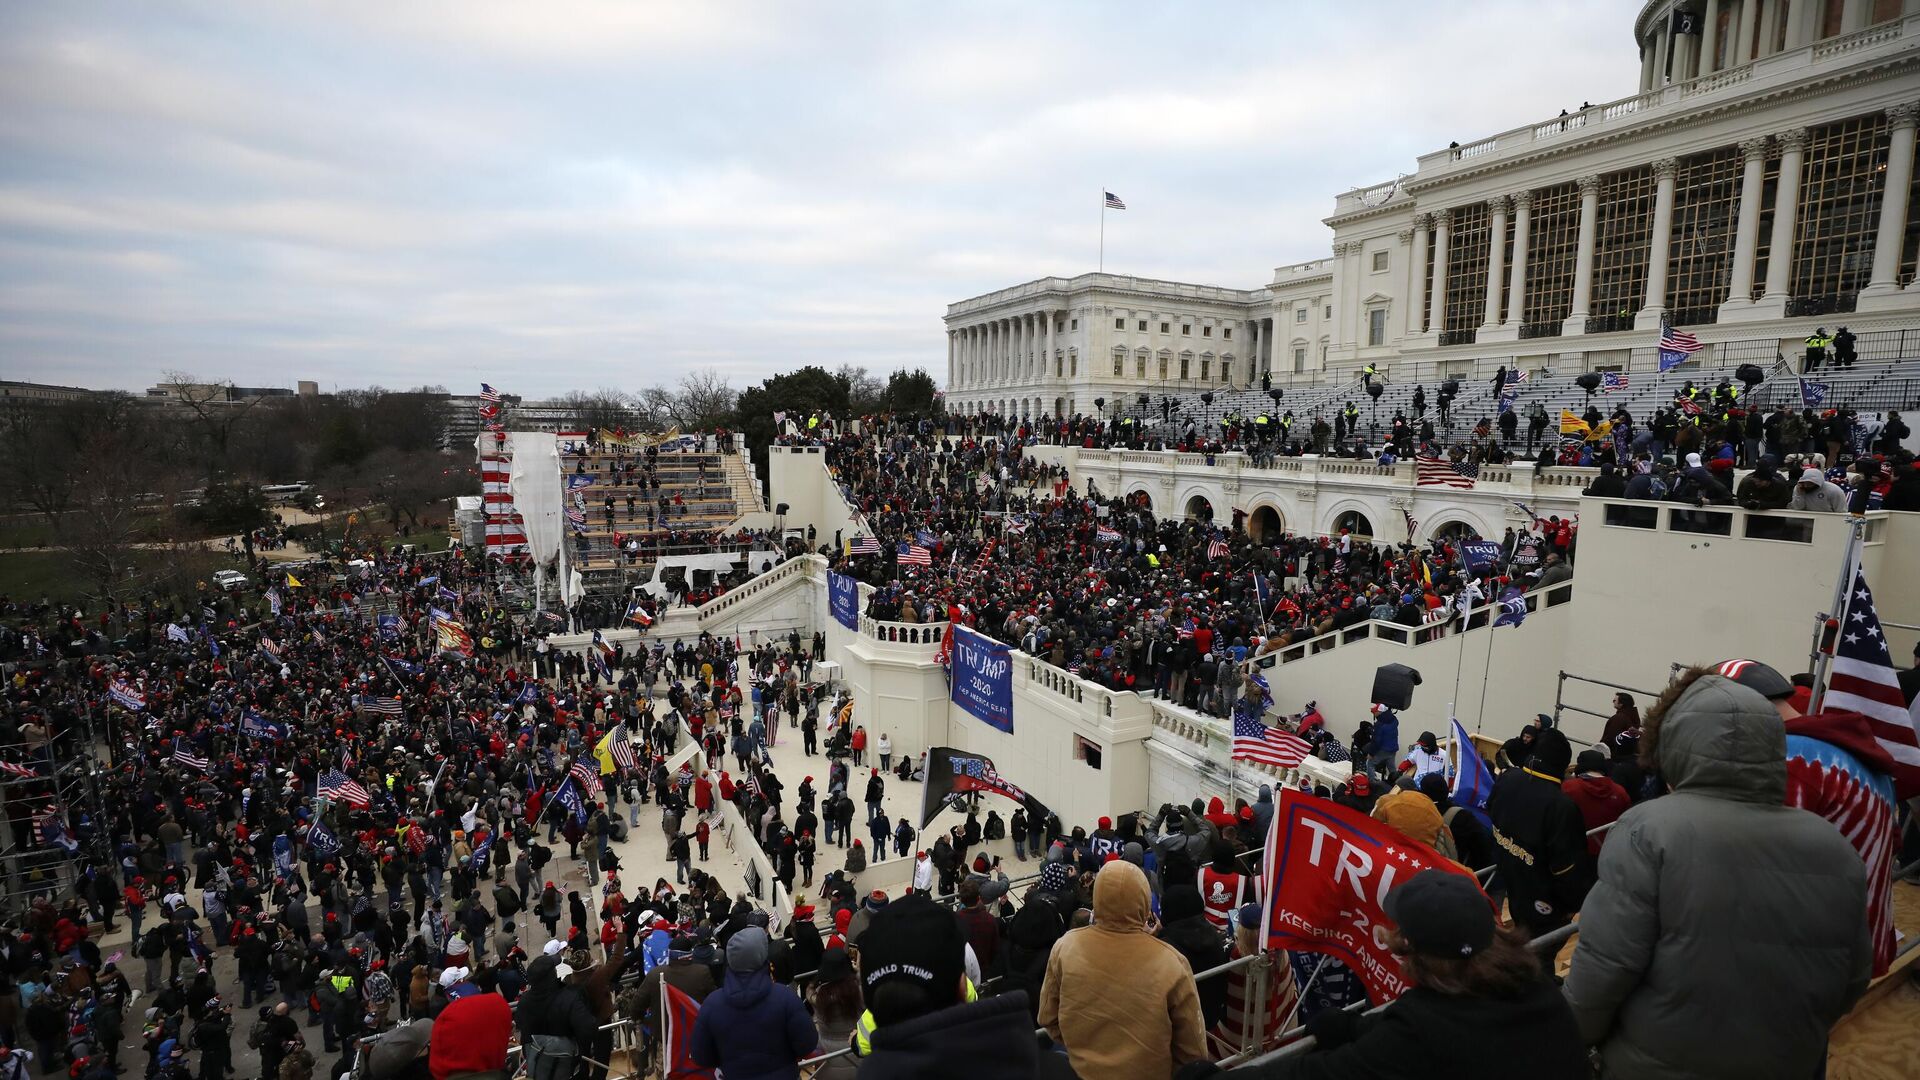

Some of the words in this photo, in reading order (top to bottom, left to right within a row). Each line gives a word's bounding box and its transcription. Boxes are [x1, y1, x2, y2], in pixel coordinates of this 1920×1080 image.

[957, 642, 1007, 680] TRUMP
[969, 692, 990, 708] AMERICA
[1279, 908, 1354, 947] KEEPING
[867, 964, 898, 985] DONALD
[902, 964, 934, 981] TRUMP
